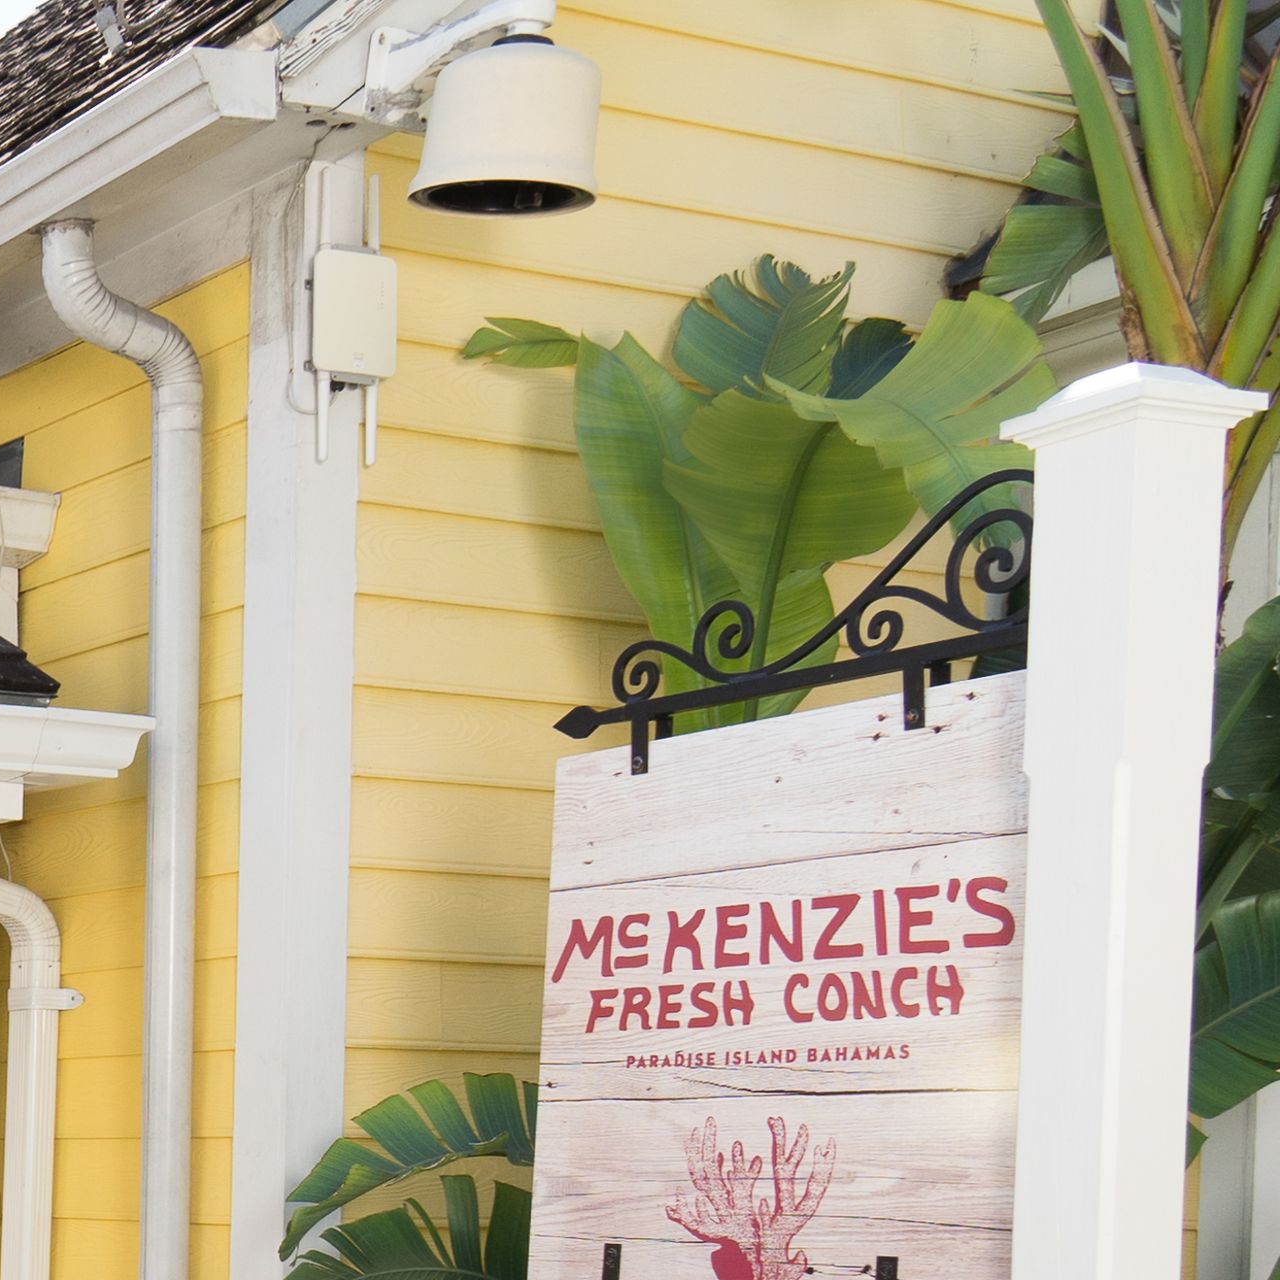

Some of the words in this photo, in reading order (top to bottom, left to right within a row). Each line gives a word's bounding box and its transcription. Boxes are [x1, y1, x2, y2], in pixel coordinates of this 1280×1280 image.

[584, 980, 756, 1034] FRESH
[783, 964, 966, 1024] CONCH
[626, 1052, 716, 1069] PARADISE
[725, 1048, 797, 1065] ISLAND
[807, 1044, 911, 1063] BAHAMAS
